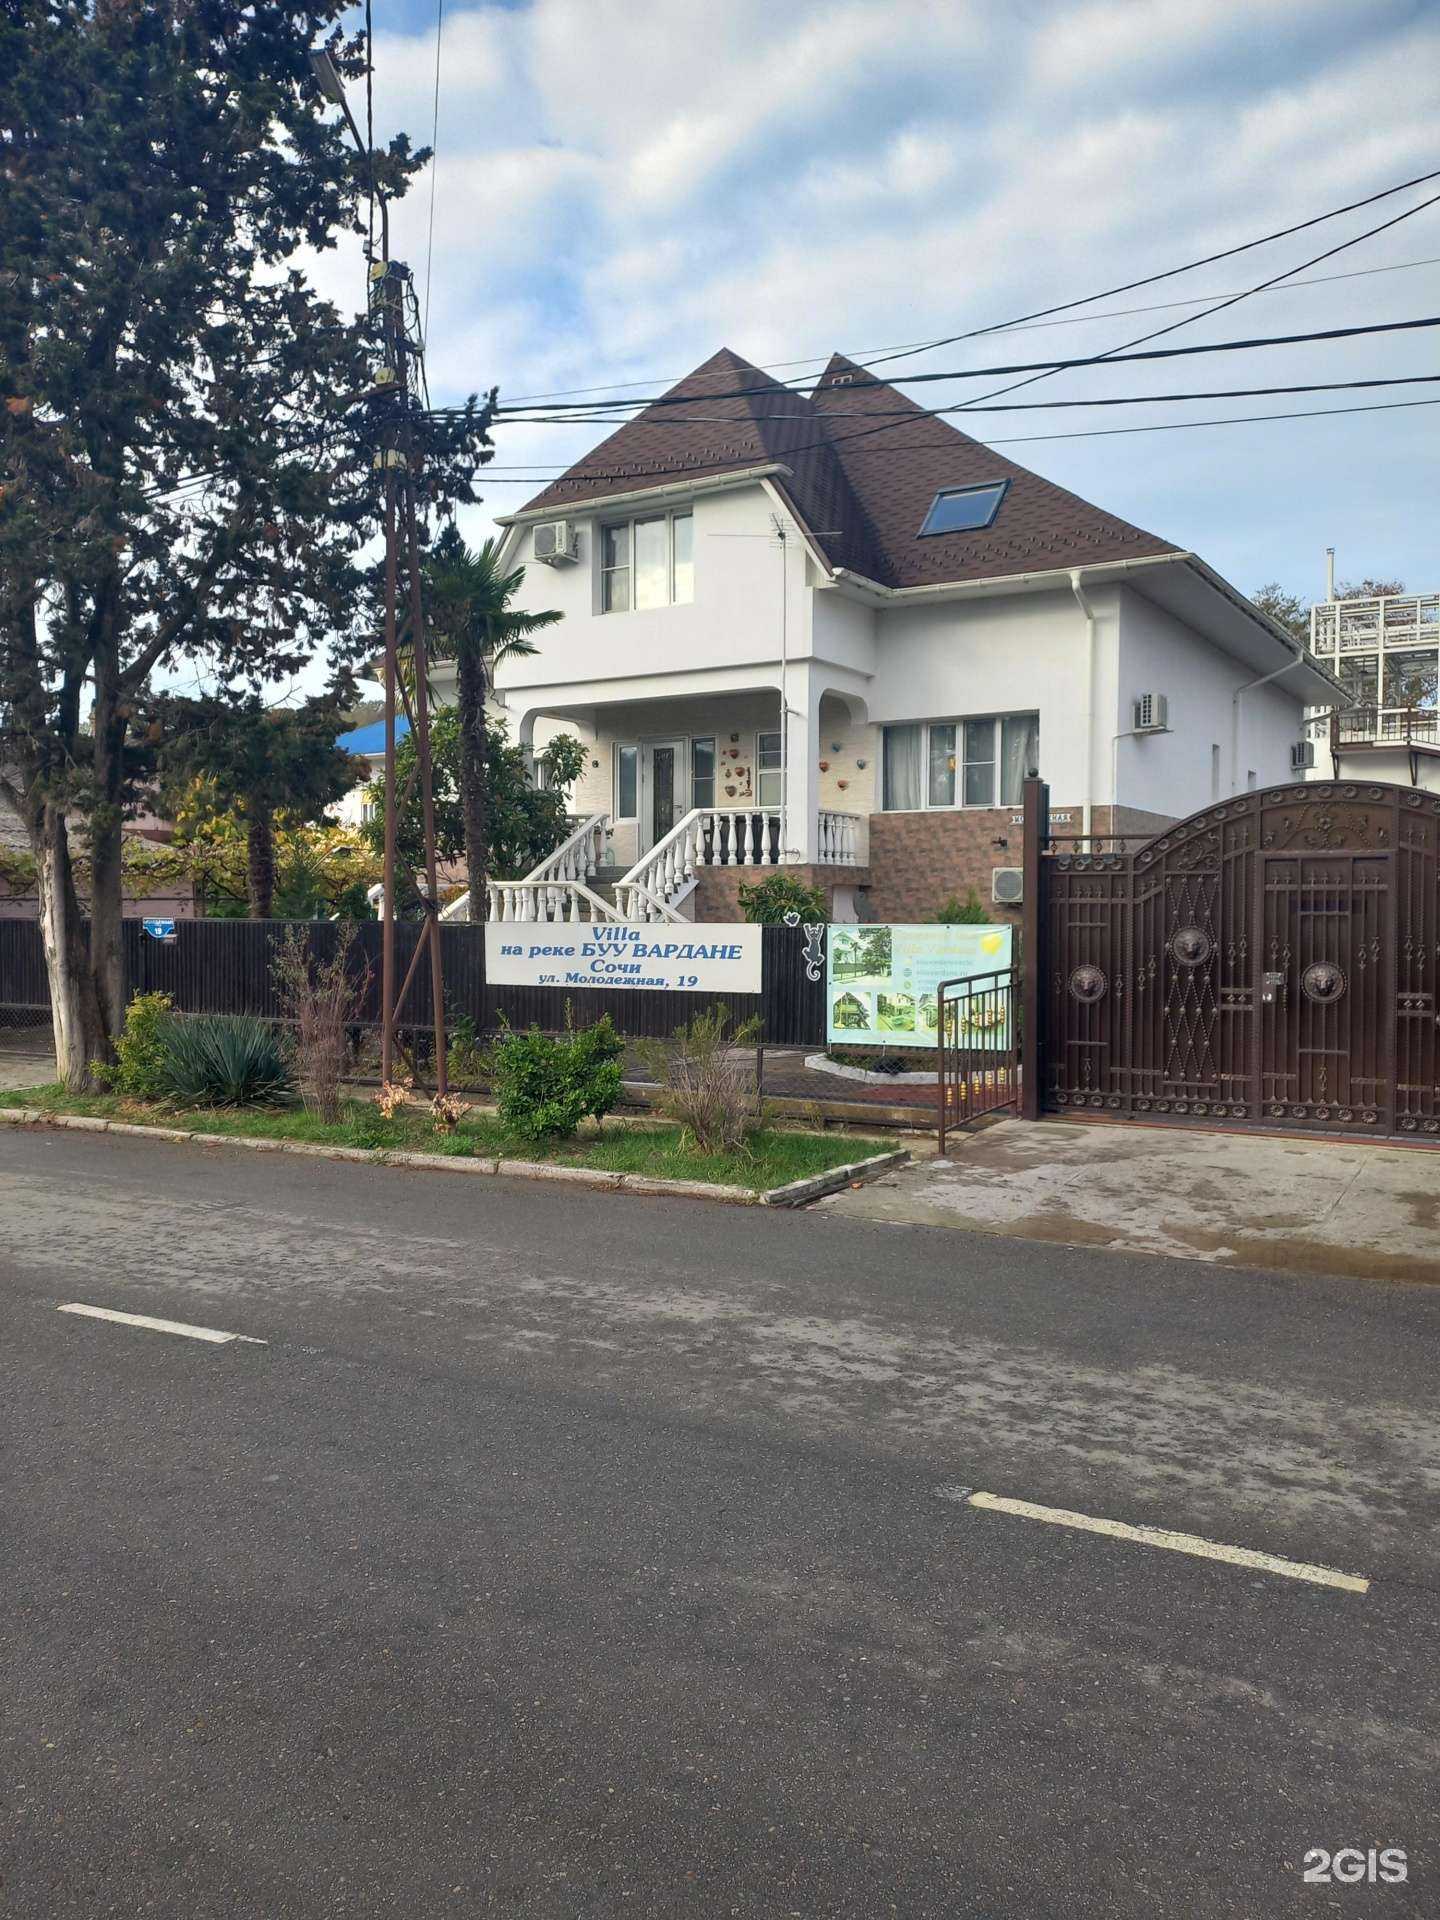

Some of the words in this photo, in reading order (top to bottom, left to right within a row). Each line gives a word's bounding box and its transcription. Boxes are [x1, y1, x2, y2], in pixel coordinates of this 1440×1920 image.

[592, 926, 641, 941] Villa
[500, 945, 523, 956] на
[528, 945, 575, 958] реке
[581, 943, 628, 957] БУУ
[631, 943, 743, 960] ВАРДАНЕ
[590, 959, 642, 974] Сочи
[538, 973, 560, 984] ул.
[564, 972, 670, 988] Молодежная,
[677, 975, 699, 988] 19
